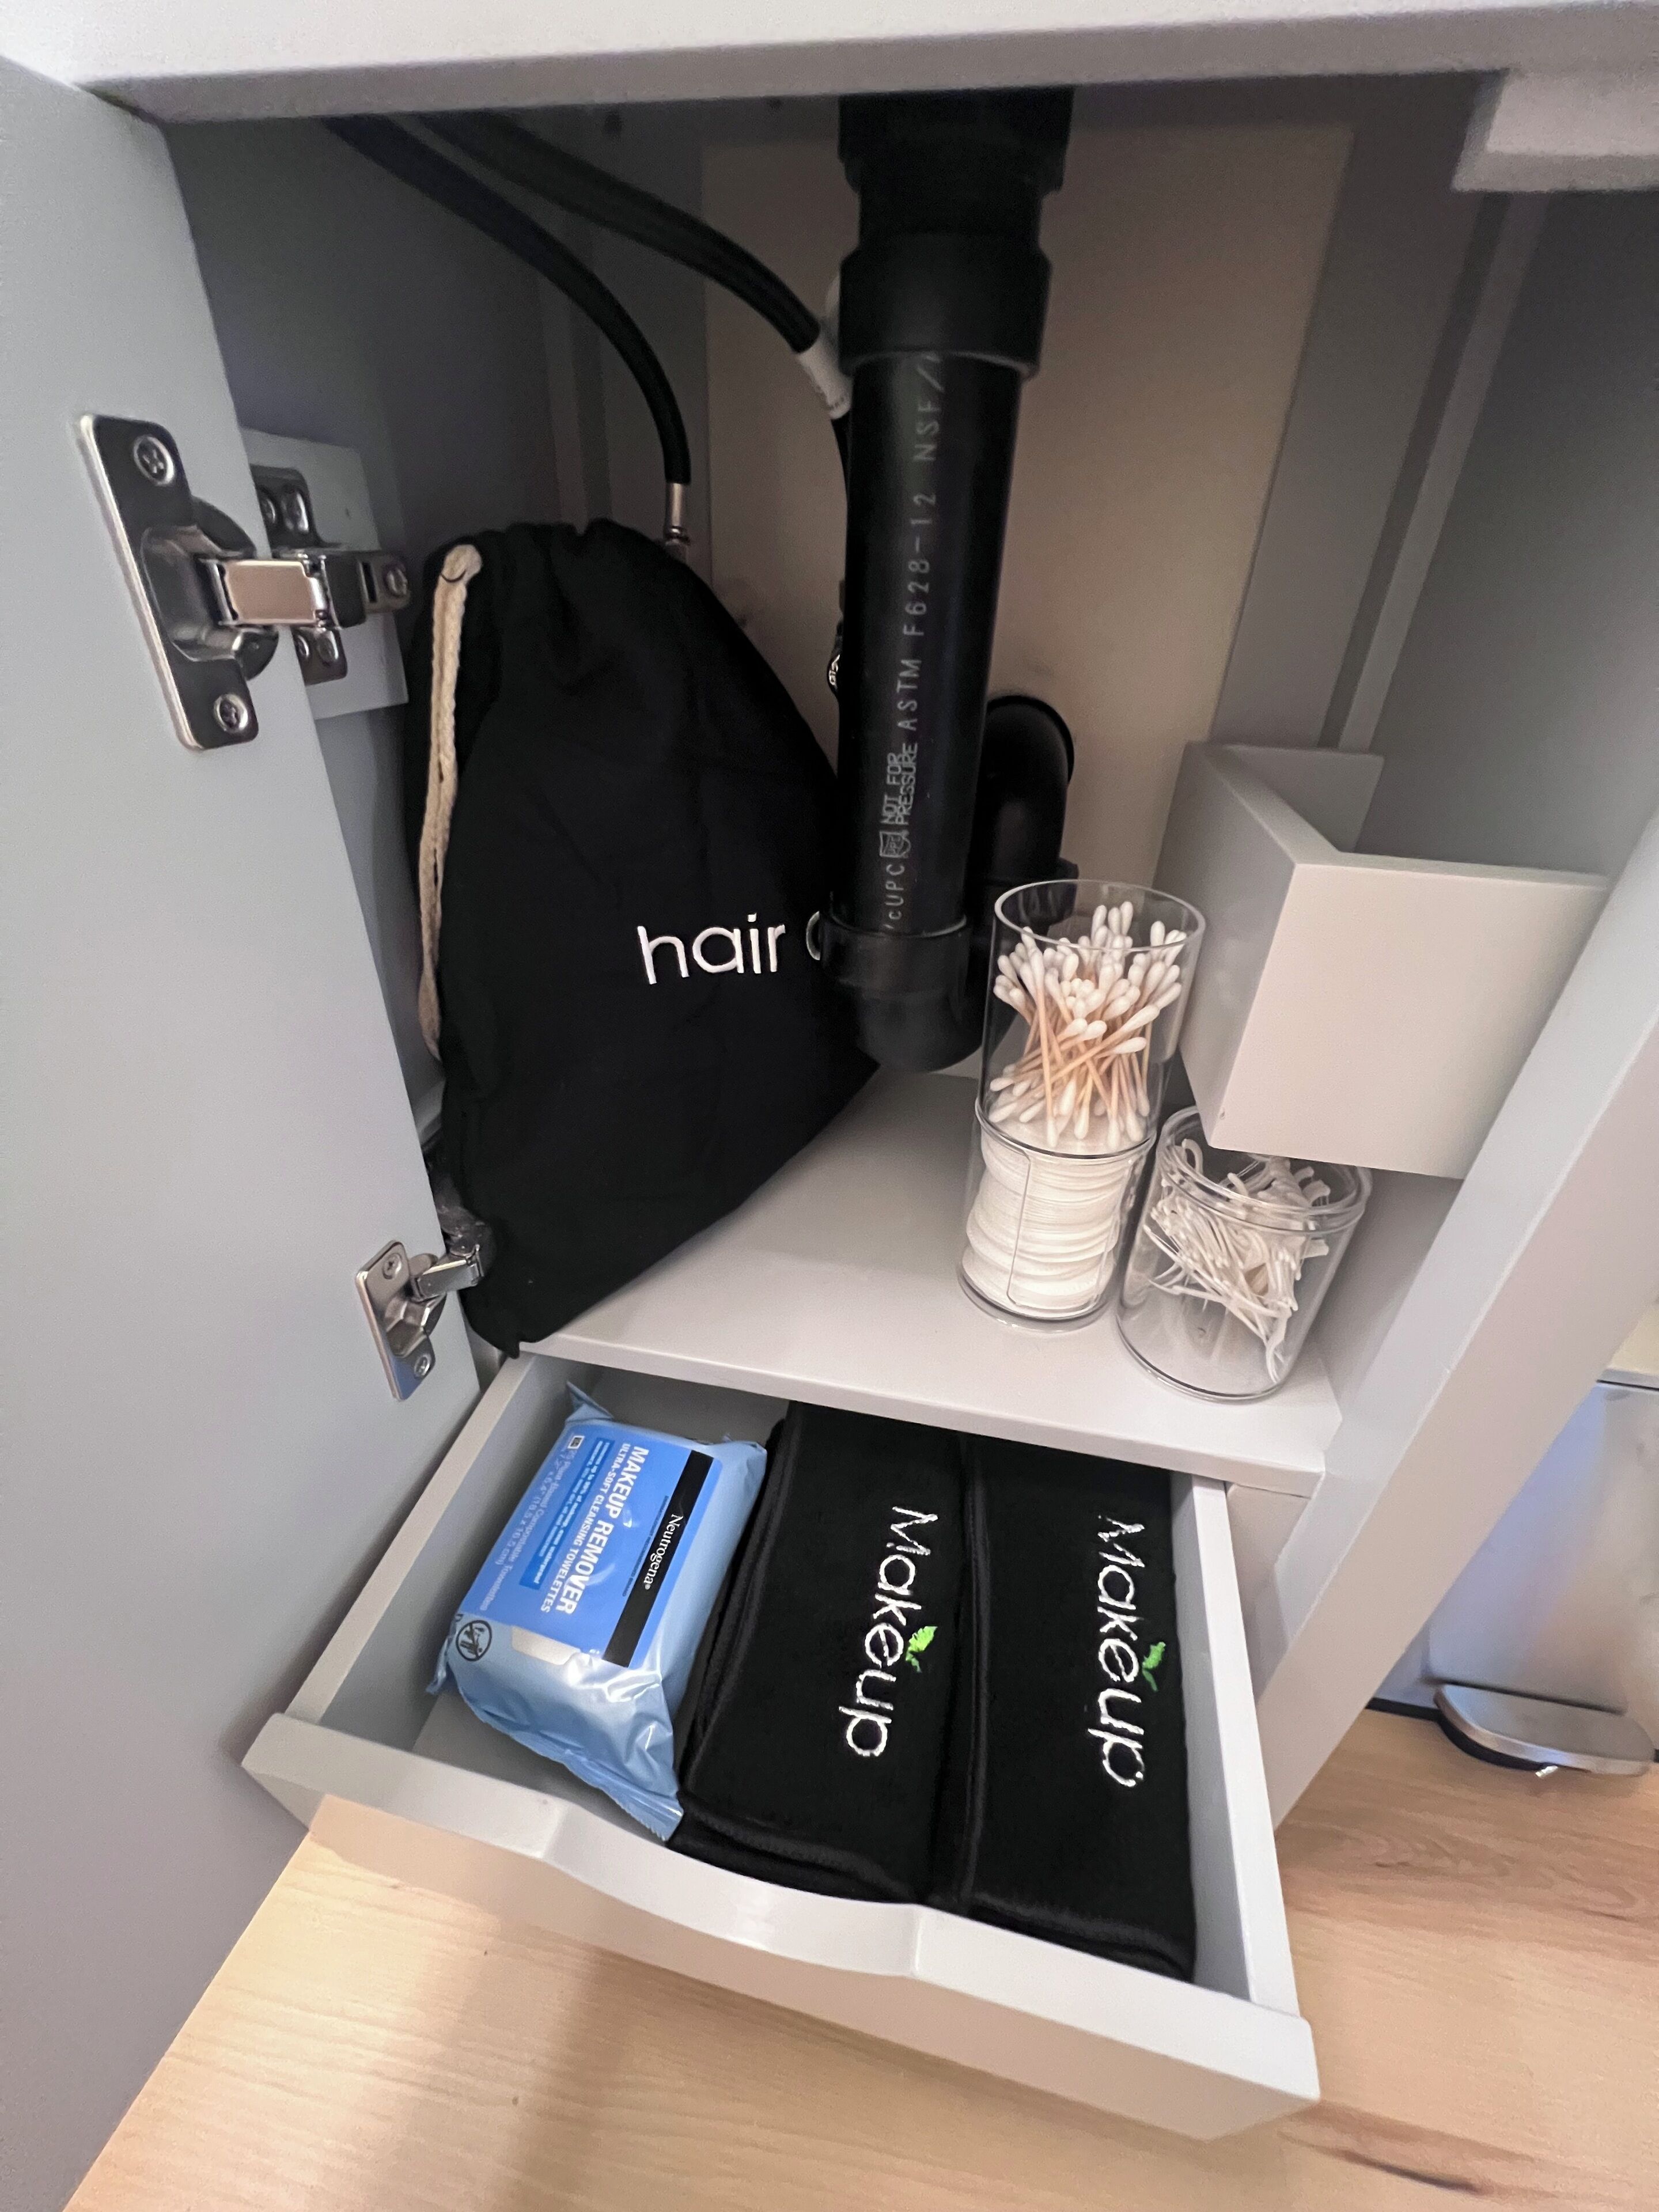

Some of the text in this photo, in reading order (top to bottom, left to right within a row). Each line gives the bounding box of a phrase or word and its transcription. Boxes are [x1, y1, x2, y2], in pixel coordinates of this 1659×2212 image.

[902, 493, 936, 636] F628-12
[896, 660, 922, 731] ASTM
[880, 752, 902, 824] NOT FOR
[896, 743, 918, 824] PRESSURE
[637, 912, 786, 984] hair
[540, 1443, 631, 1613] ULTRA-SOFT CLEANSING TOWELETTES
[556, 1446, 650, 1615] MAKEUP REMOVER
[839, 1506, 938, 1757] Makeup
[1087, 1515, 1145, 1788] Makeup
